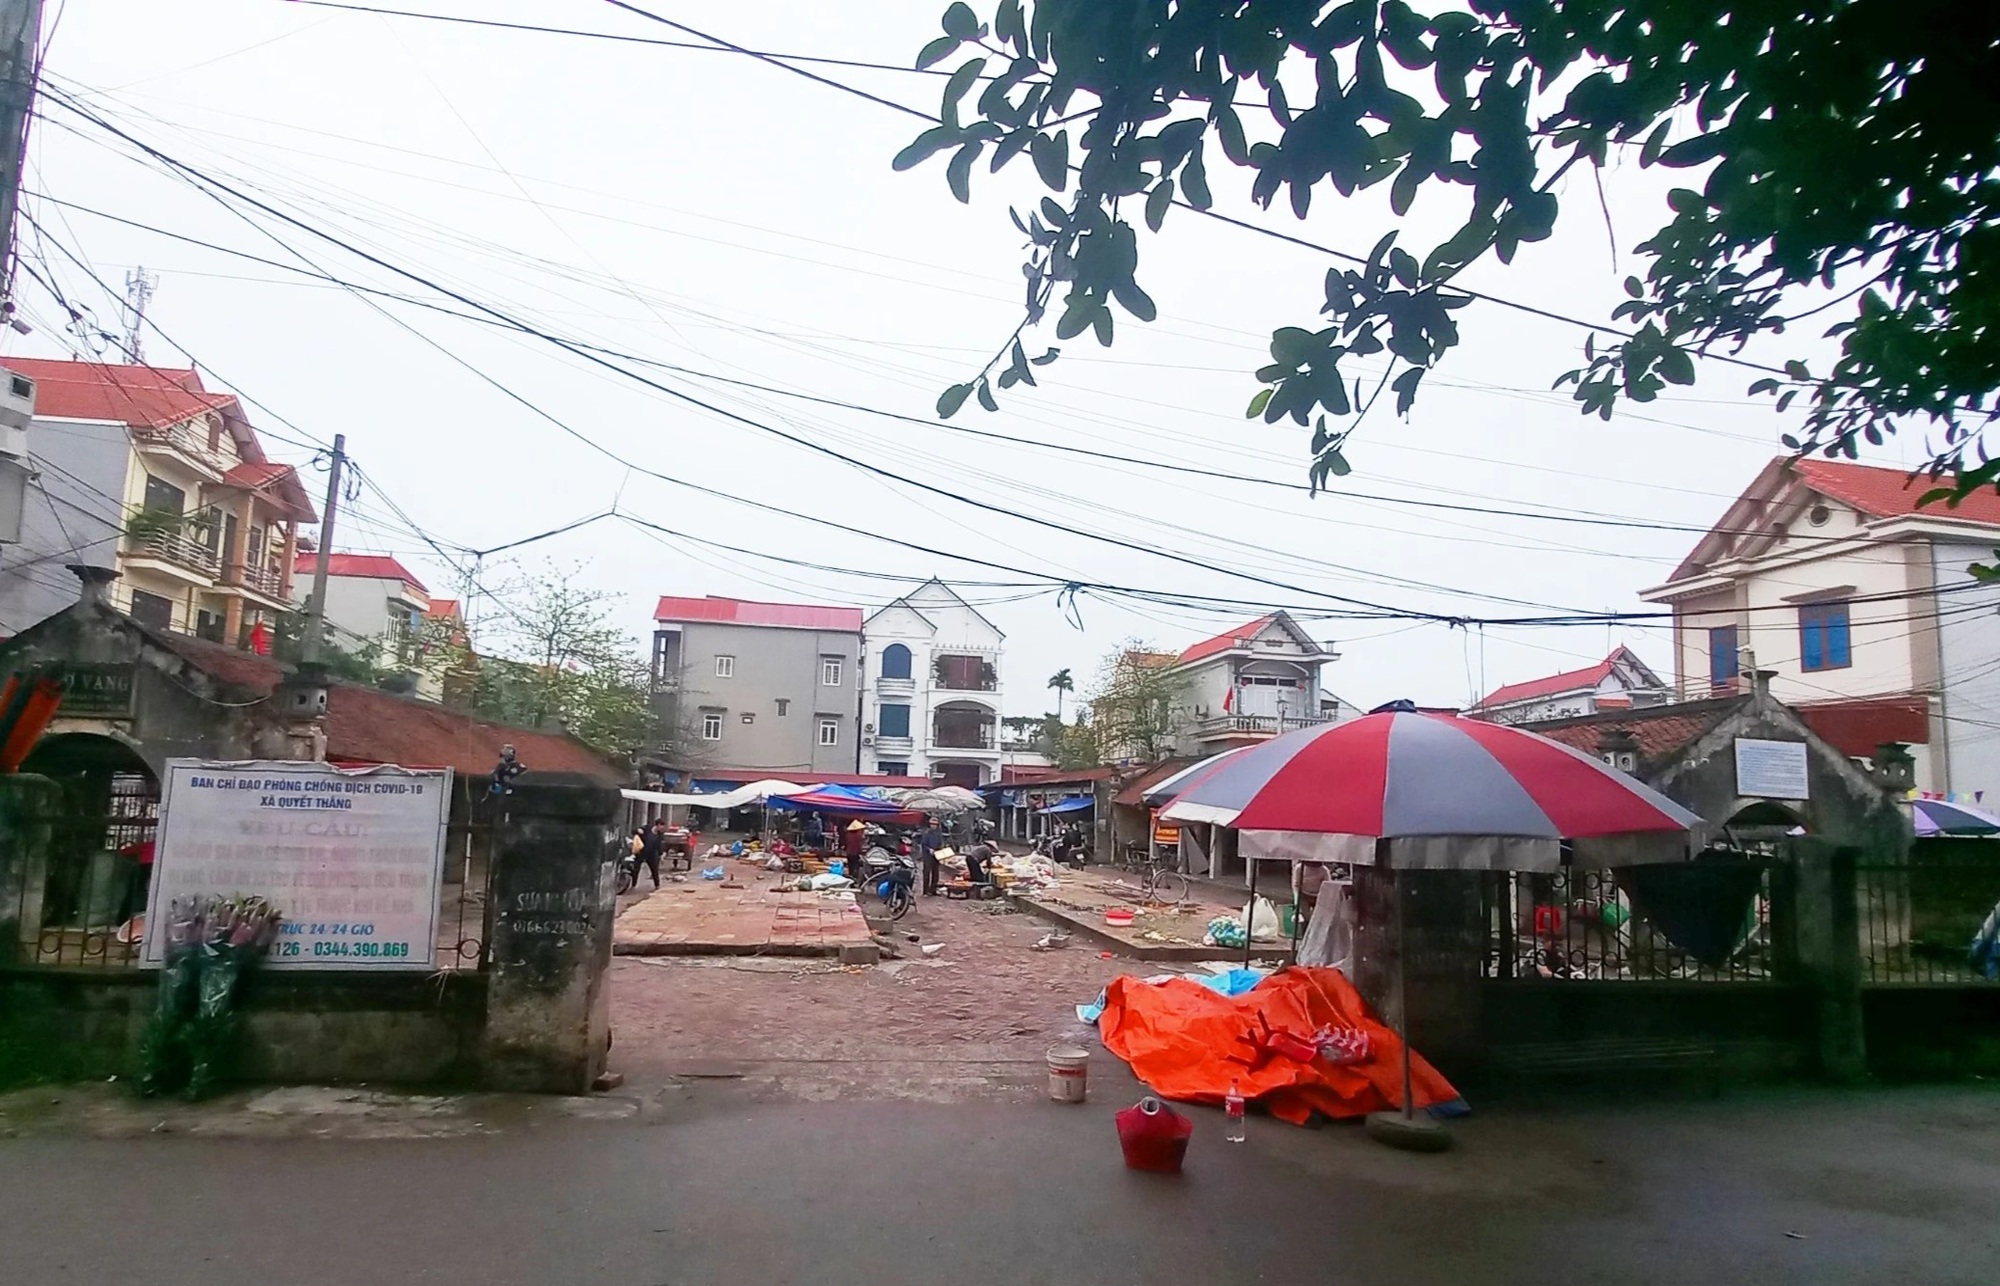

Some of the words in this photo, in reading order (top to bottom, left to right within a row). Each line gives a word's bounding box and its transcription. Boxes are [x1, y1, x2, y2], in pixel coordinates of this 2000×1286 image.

[191, 777, 214, 788] BAN
[239, 779, 261, 792] ĐẠO
[264, 778, 303, 791] PHÒNG
[305, 778, 342, 792] CHỐNG
[345, 782, 371, 795] DỊCH
[374, 783, 424, 795] COVID-19
[278, 795, 312, 808] QUYẾT
[316, 796, 352, 809] THẮNG
[314, 941, 409, 958] 0344.390.869
